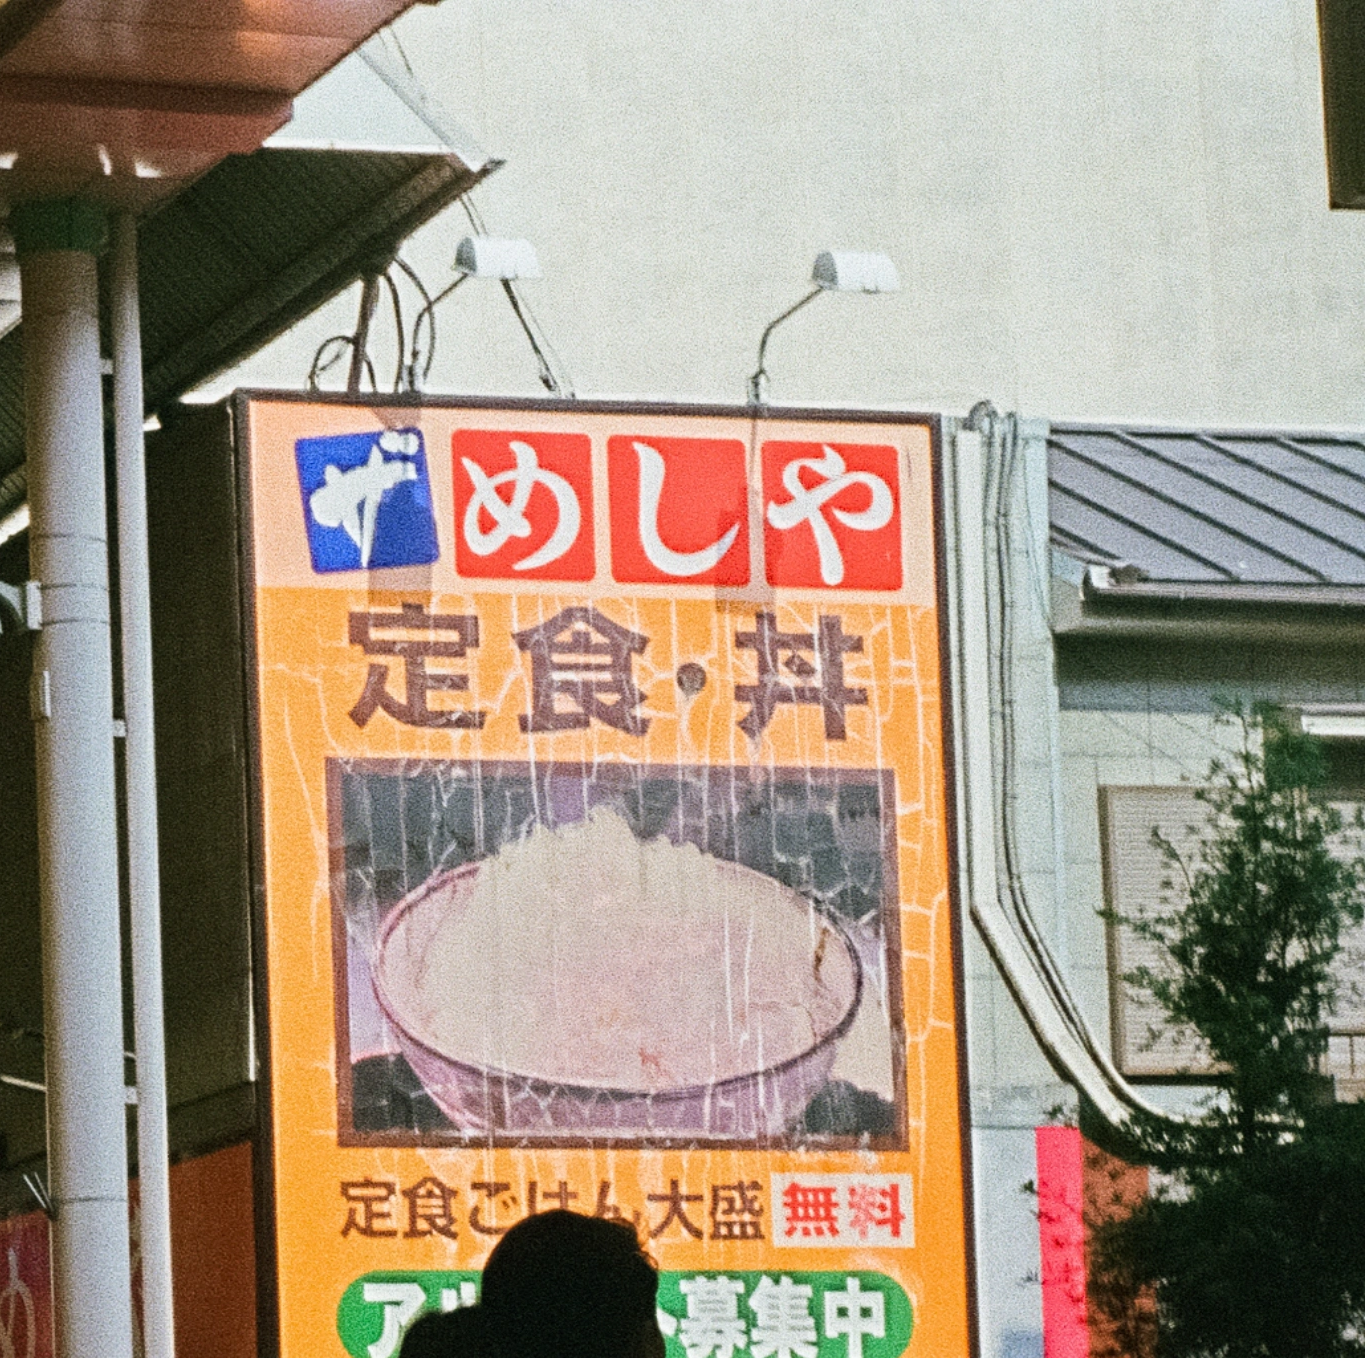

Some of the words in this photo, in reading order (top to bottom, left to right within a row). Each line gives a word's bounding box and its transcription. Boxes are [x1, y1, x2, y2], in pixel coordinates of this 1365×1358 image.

[346, 603, 869, 742] 定食・丼
[782, 1182, 906, 1240] 無料
